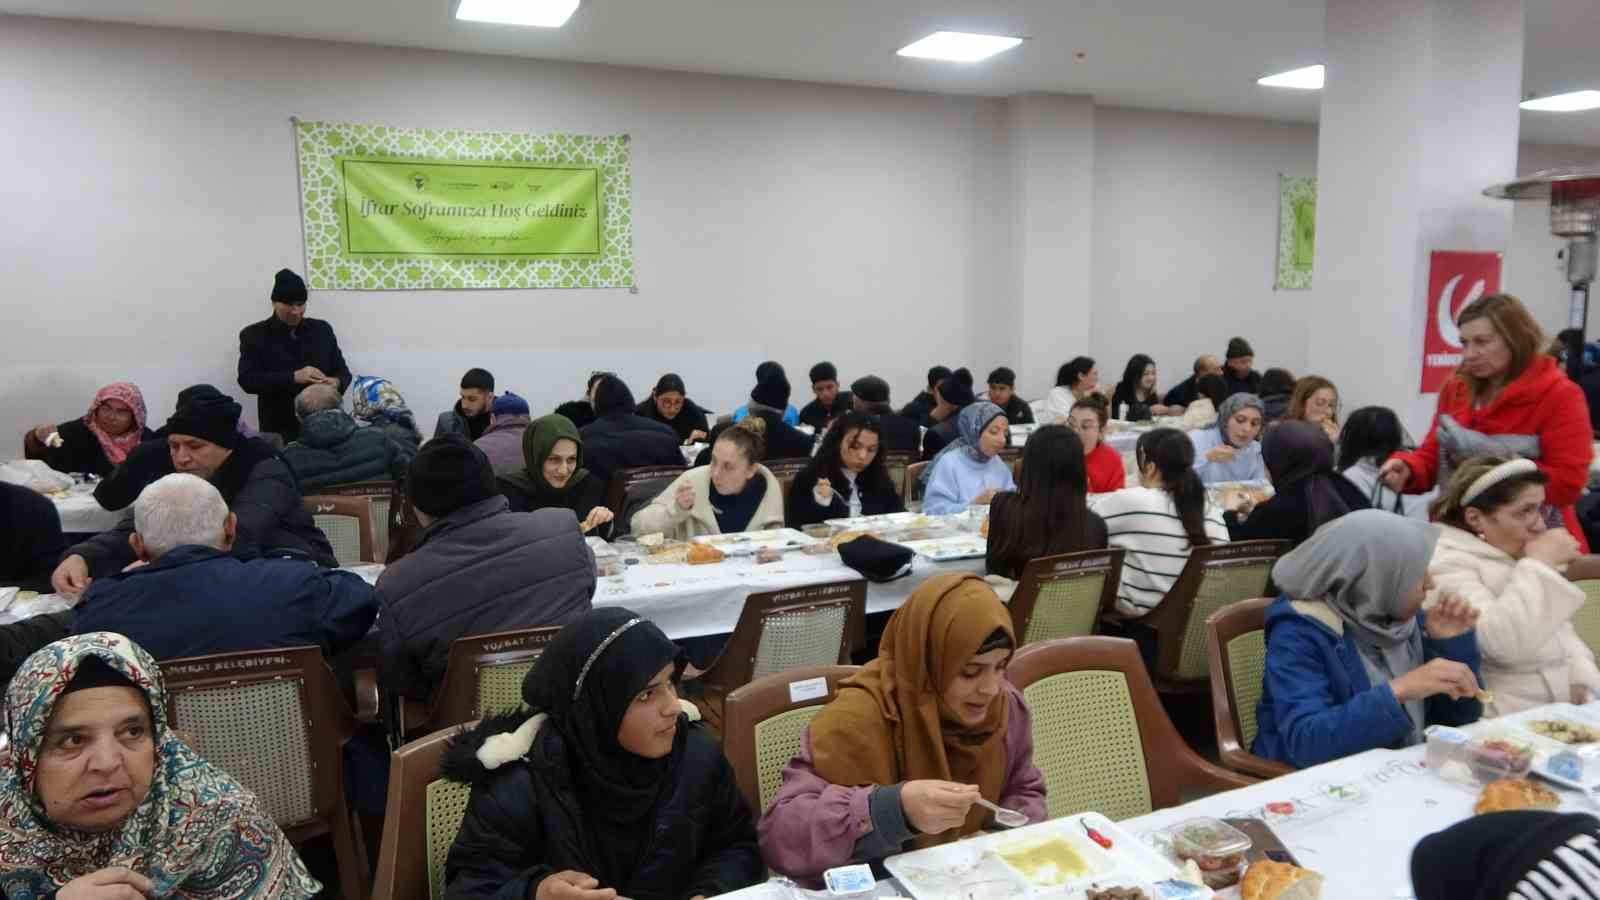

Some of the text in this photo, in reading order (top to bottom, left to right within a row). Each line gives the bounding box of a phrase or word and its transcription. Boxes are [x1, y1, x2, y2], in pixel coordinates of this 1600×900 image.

[360, 195, 398, 218] İftar
[491, 202, 520, 221] Hoş
[525, 200, 588, 218] Geldiniz
